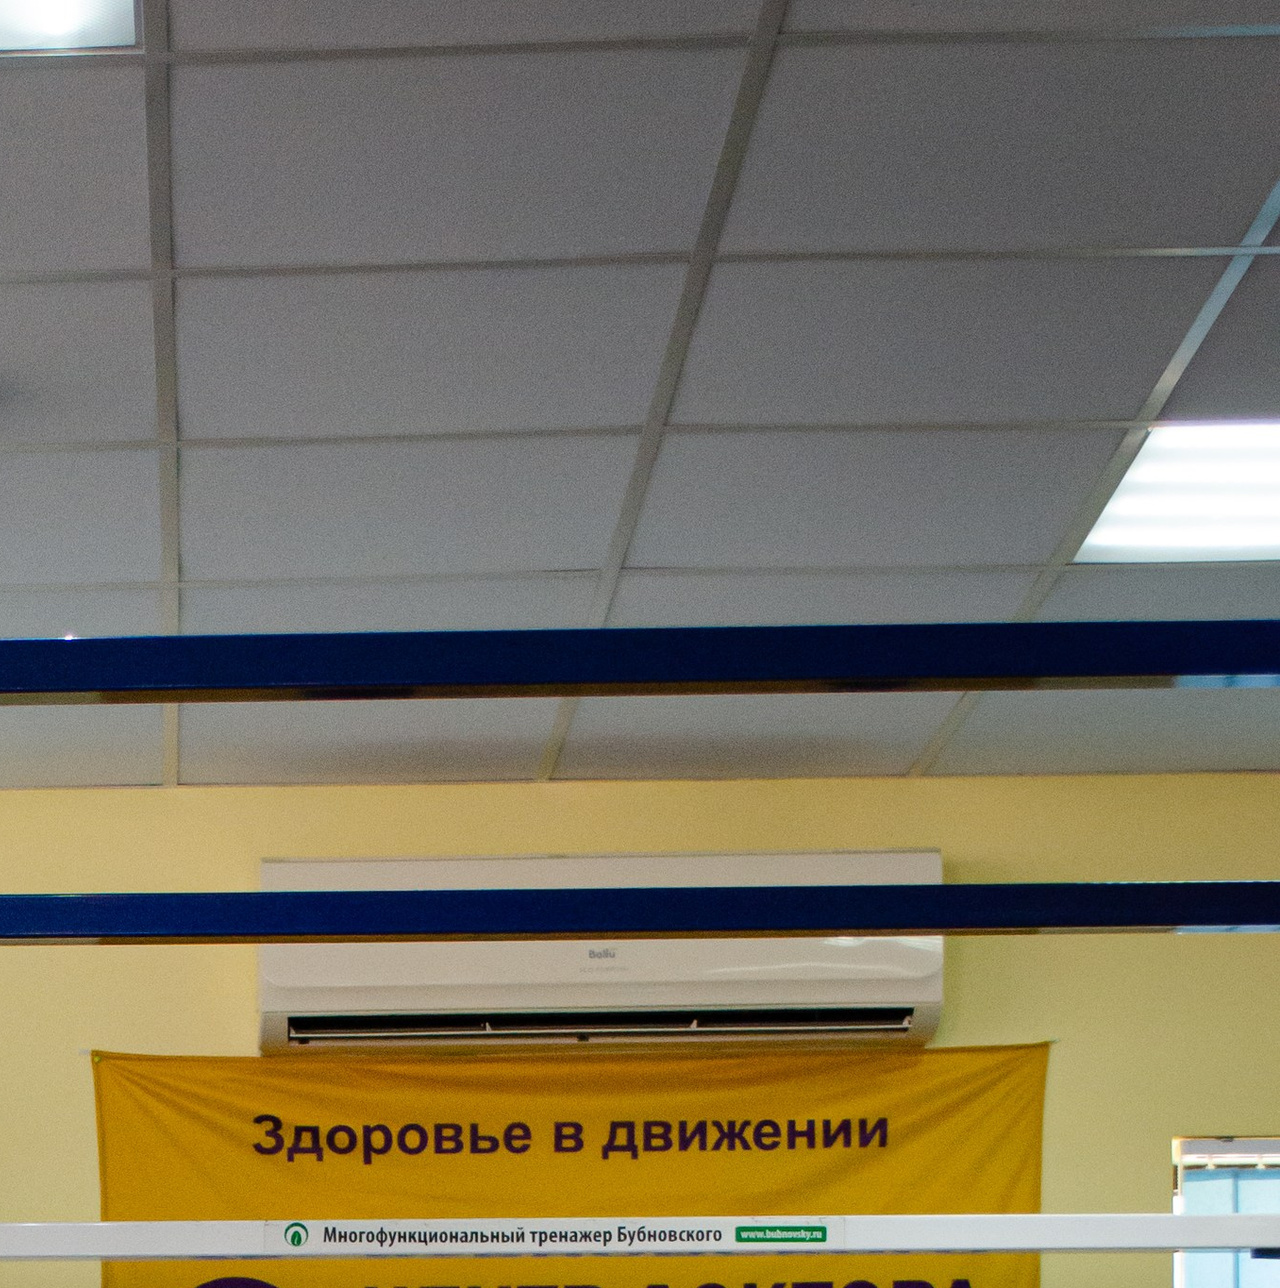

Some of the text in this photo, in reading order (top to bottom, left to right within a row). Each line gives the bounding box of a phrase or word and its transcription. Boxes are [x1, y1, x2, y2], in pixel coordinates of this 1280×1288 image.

[252, 1113, 889, 1165] Здоровье в движении
[322, 1225, 722, 1248] Многофункциональный тренажер Бубновского
[739, 1229, 823, 1241] www.bubnovsky.ru
